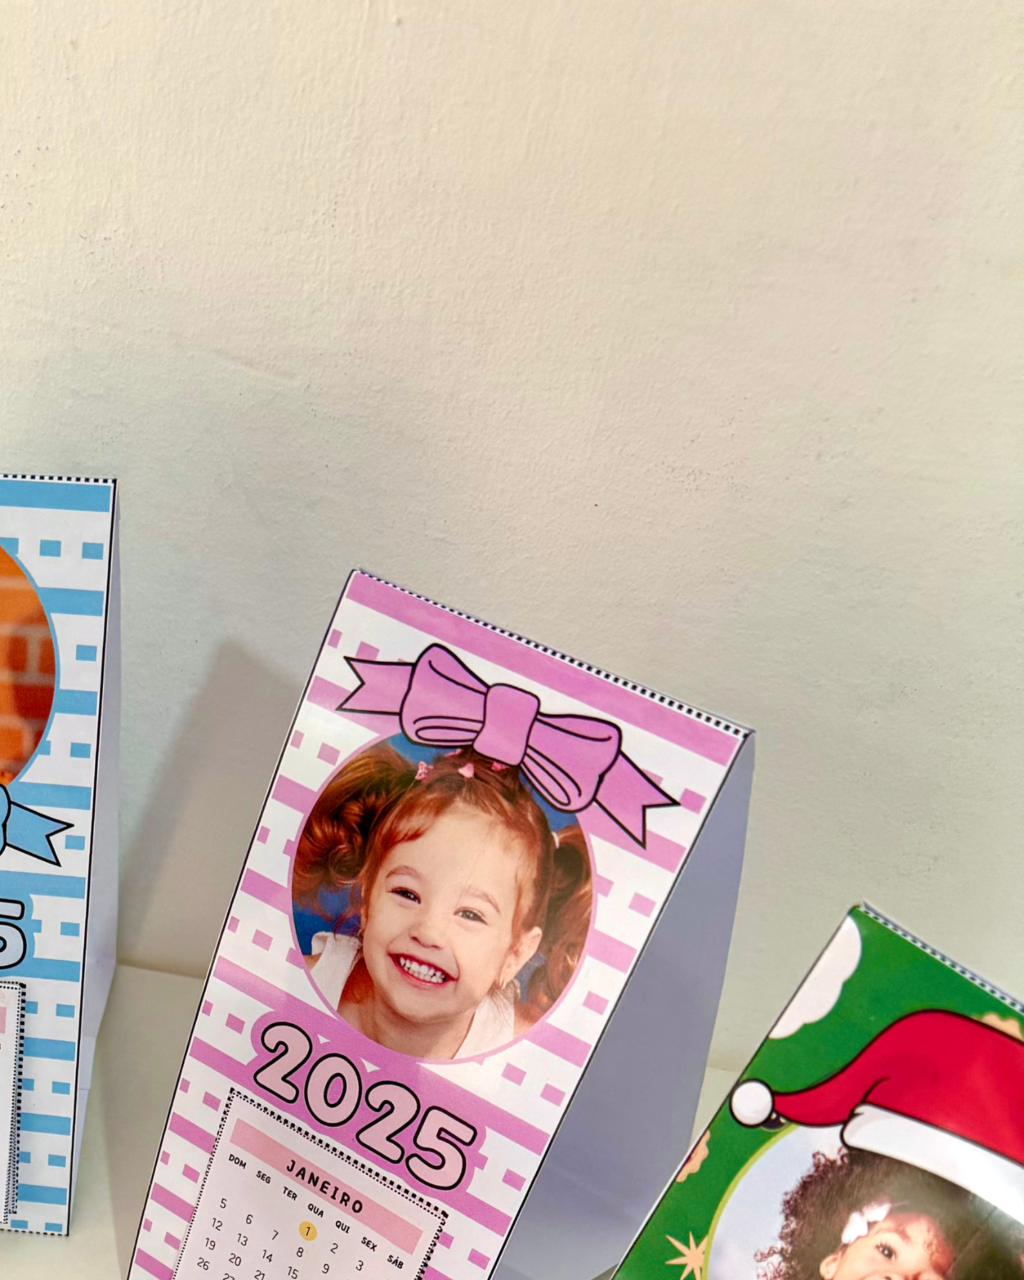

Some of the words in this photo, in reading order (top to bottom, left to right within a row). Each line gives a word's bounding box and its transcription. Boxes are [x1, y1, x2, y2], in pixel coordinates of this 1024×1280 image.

[253, 1021, 477, 1190] 2025
[228, 1154, 246, 1169] DOM
[256, 1170, 271, 1184] SEG
[283, 1186, 298, 1201] TER
[308, 1203, 324, 1218] QUA
[335, 1220, 350, 1234] QUI
[361, 1236, 378, 1252] SEX
[387, 1254, 404, 1269] SÁB
[286, 1159, 364, 1215] JANEIRO
[212, 1218, 223, 1231] 12
[237, 1233, 248, 1246] 13
[262, 1249, 273, 1263] 14
[288, 1266, 299, 1280] 15
[220, 1198, 227, 1209] 5
[246, 1214, 254, 1224] 6
[272, 1230, 279, 1240] 7
[296, 1247, 304, 1258] 8
[322, 1263, 330, 1274] 9
[306, 1227, 311, 1236] 1
[330, 1243, 338, 1254] 2
[356, 1260, 364, 1271] 3
